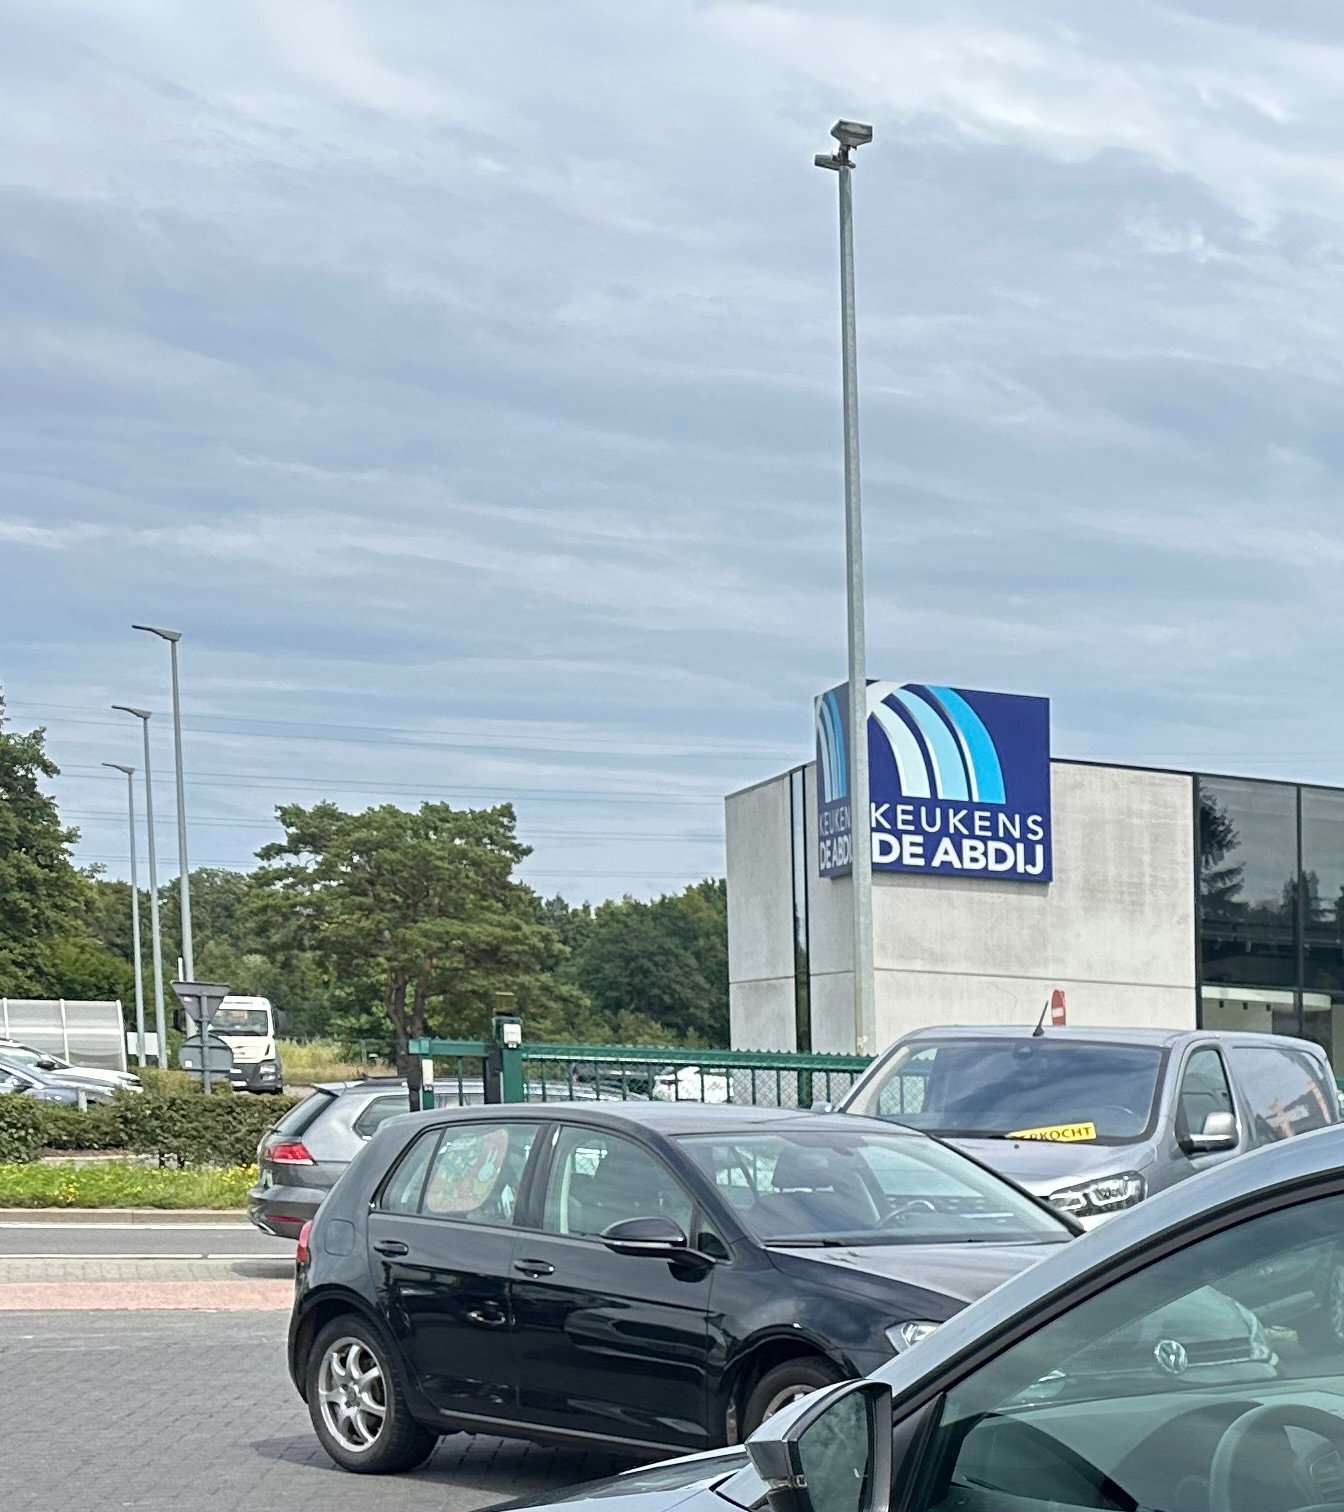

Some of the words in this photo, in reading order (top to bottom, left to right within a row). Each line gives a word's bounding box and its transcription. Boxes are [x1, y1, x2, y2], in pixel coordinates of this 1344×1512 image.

[820, 806, 851, 836] KEUKEN
[870, 802, 1044, 841] KEUKENS
[832, 834, 854, 868] ABDI
[871, 831, 925, 867] DE
[931, 837, 1044, 875] ABDIJ
[1021, 1127, 1092, 1141] RKOCHT
